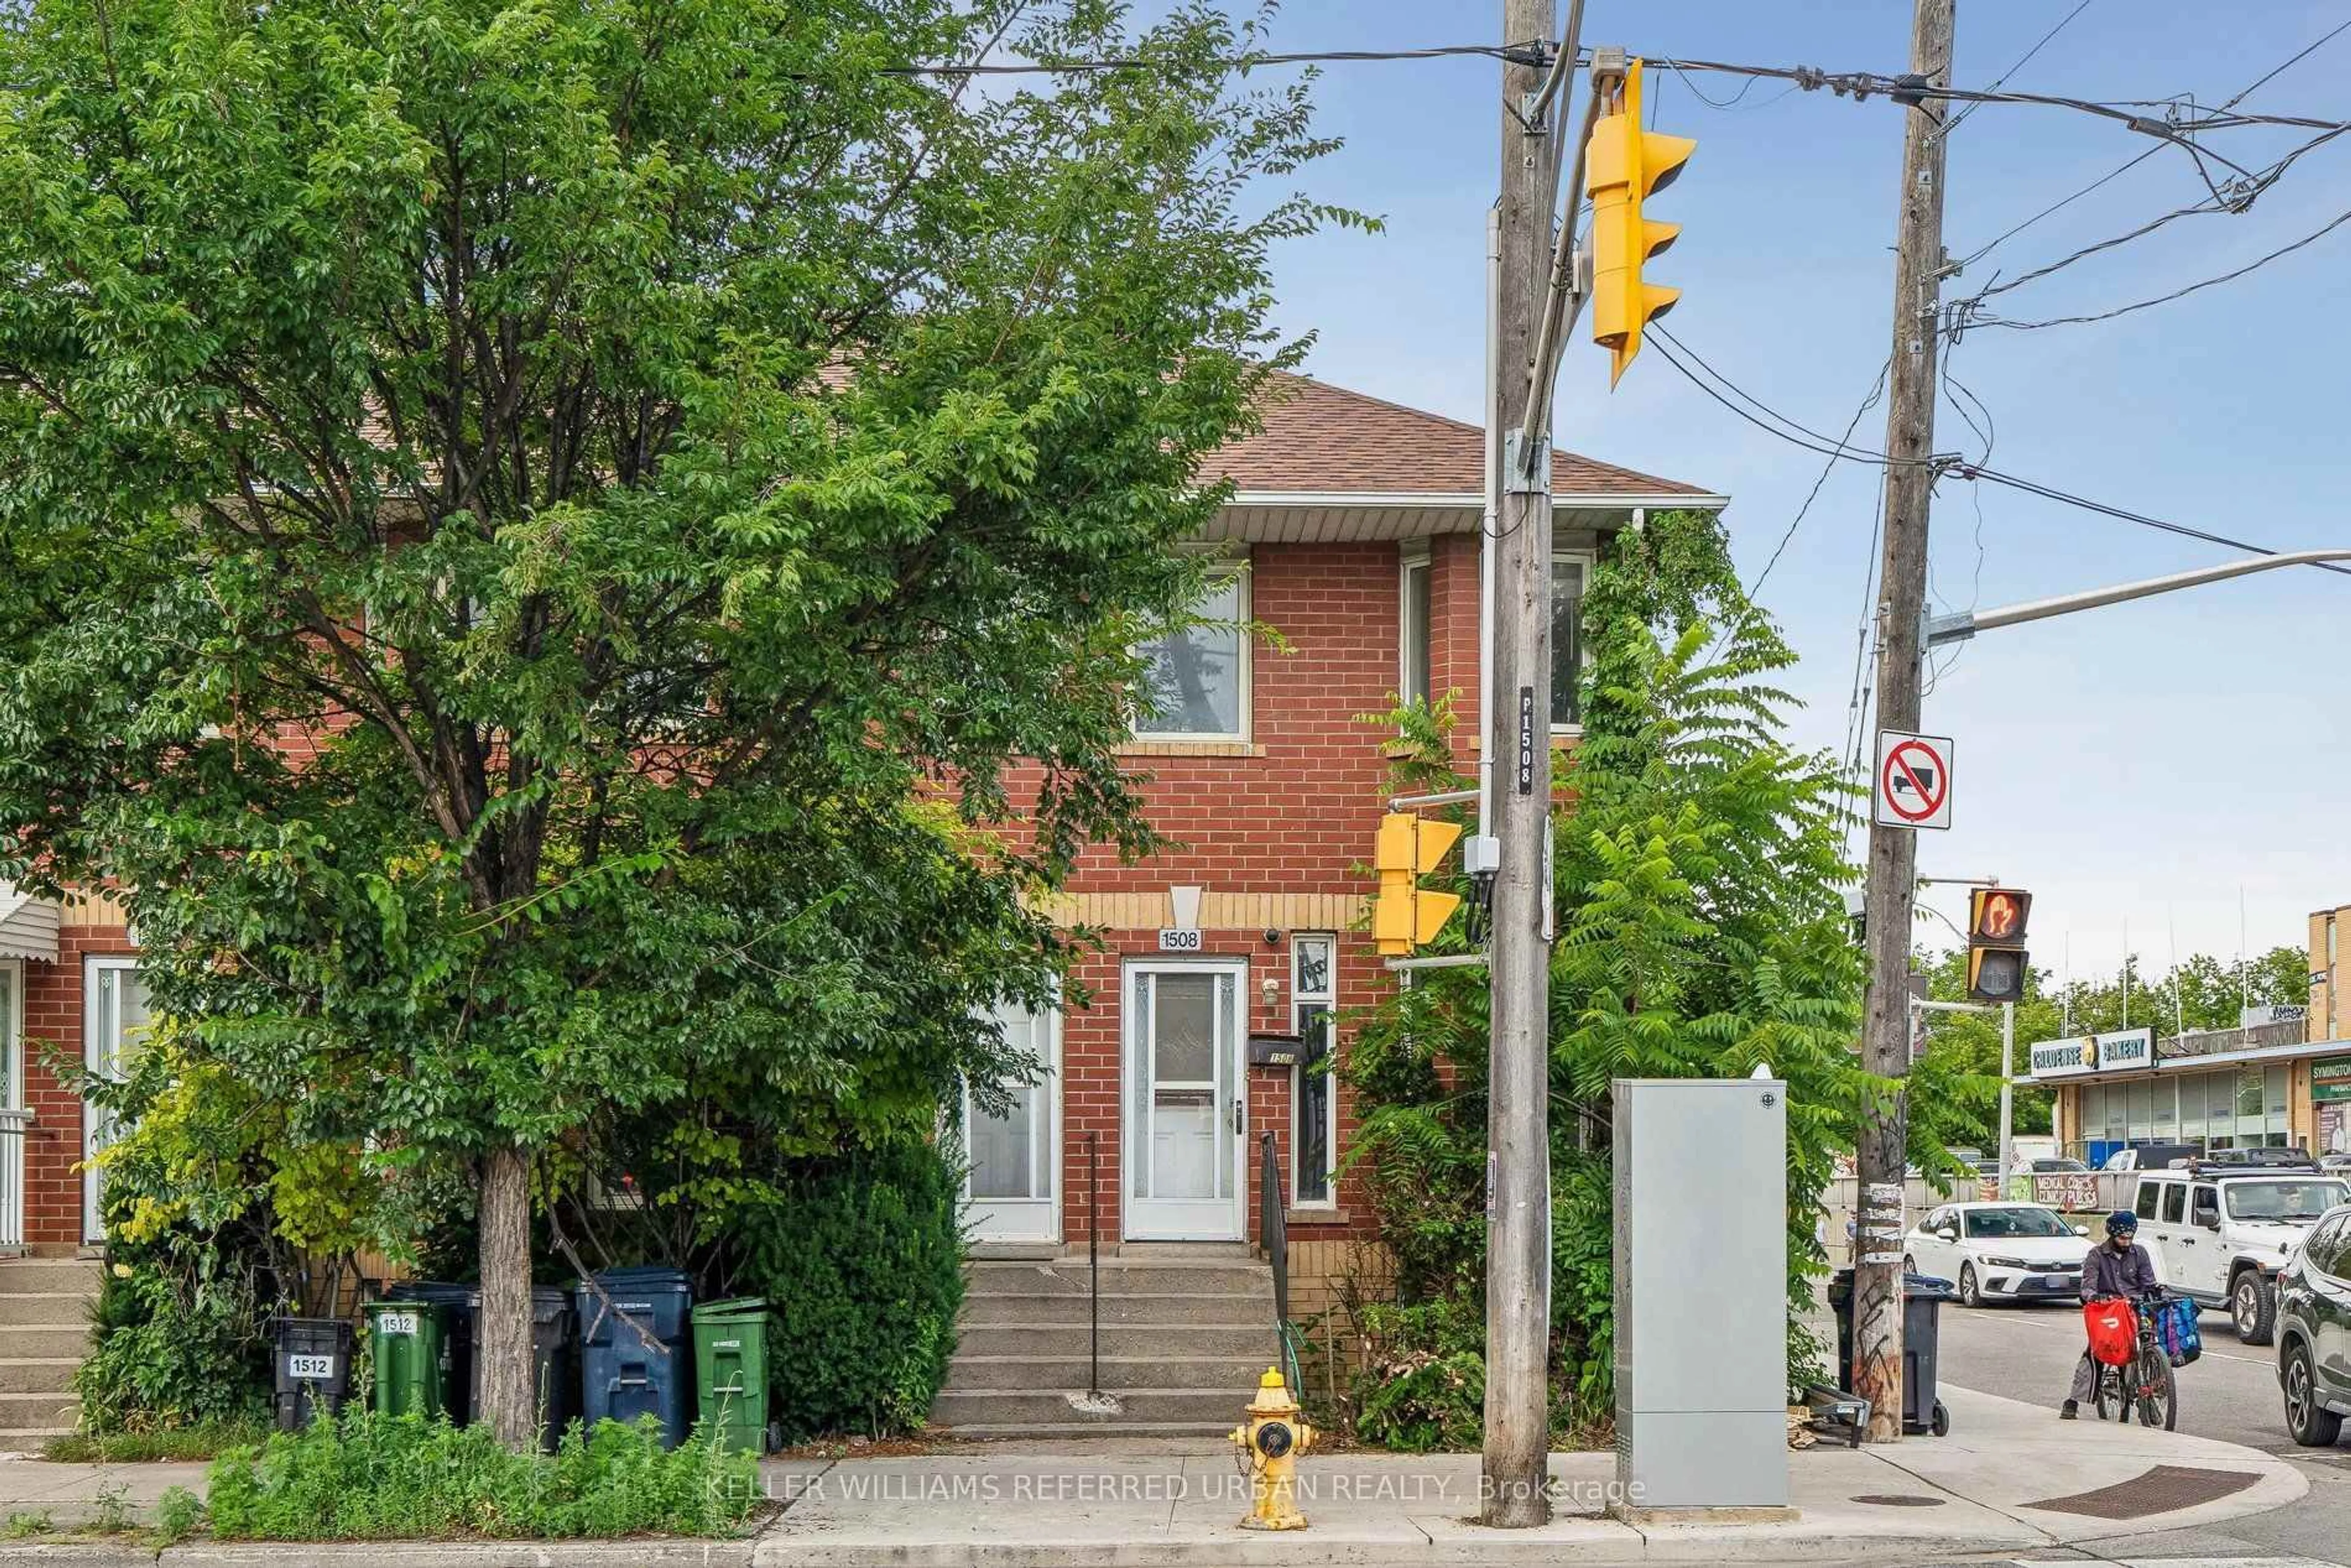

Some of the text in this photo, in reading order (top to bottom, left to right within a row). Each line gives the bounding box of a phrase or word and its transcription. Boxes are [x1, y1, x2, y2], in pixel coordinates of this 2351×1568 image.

[1521, 697, 1531, 783] P1508
[1163, 931, 1198, 948] 1508
[2103, 1038, 2145, 1061] BAKERY
[384, 1318, 412, 1331] 1512
[293, 1359, 328, 1373] 1512
